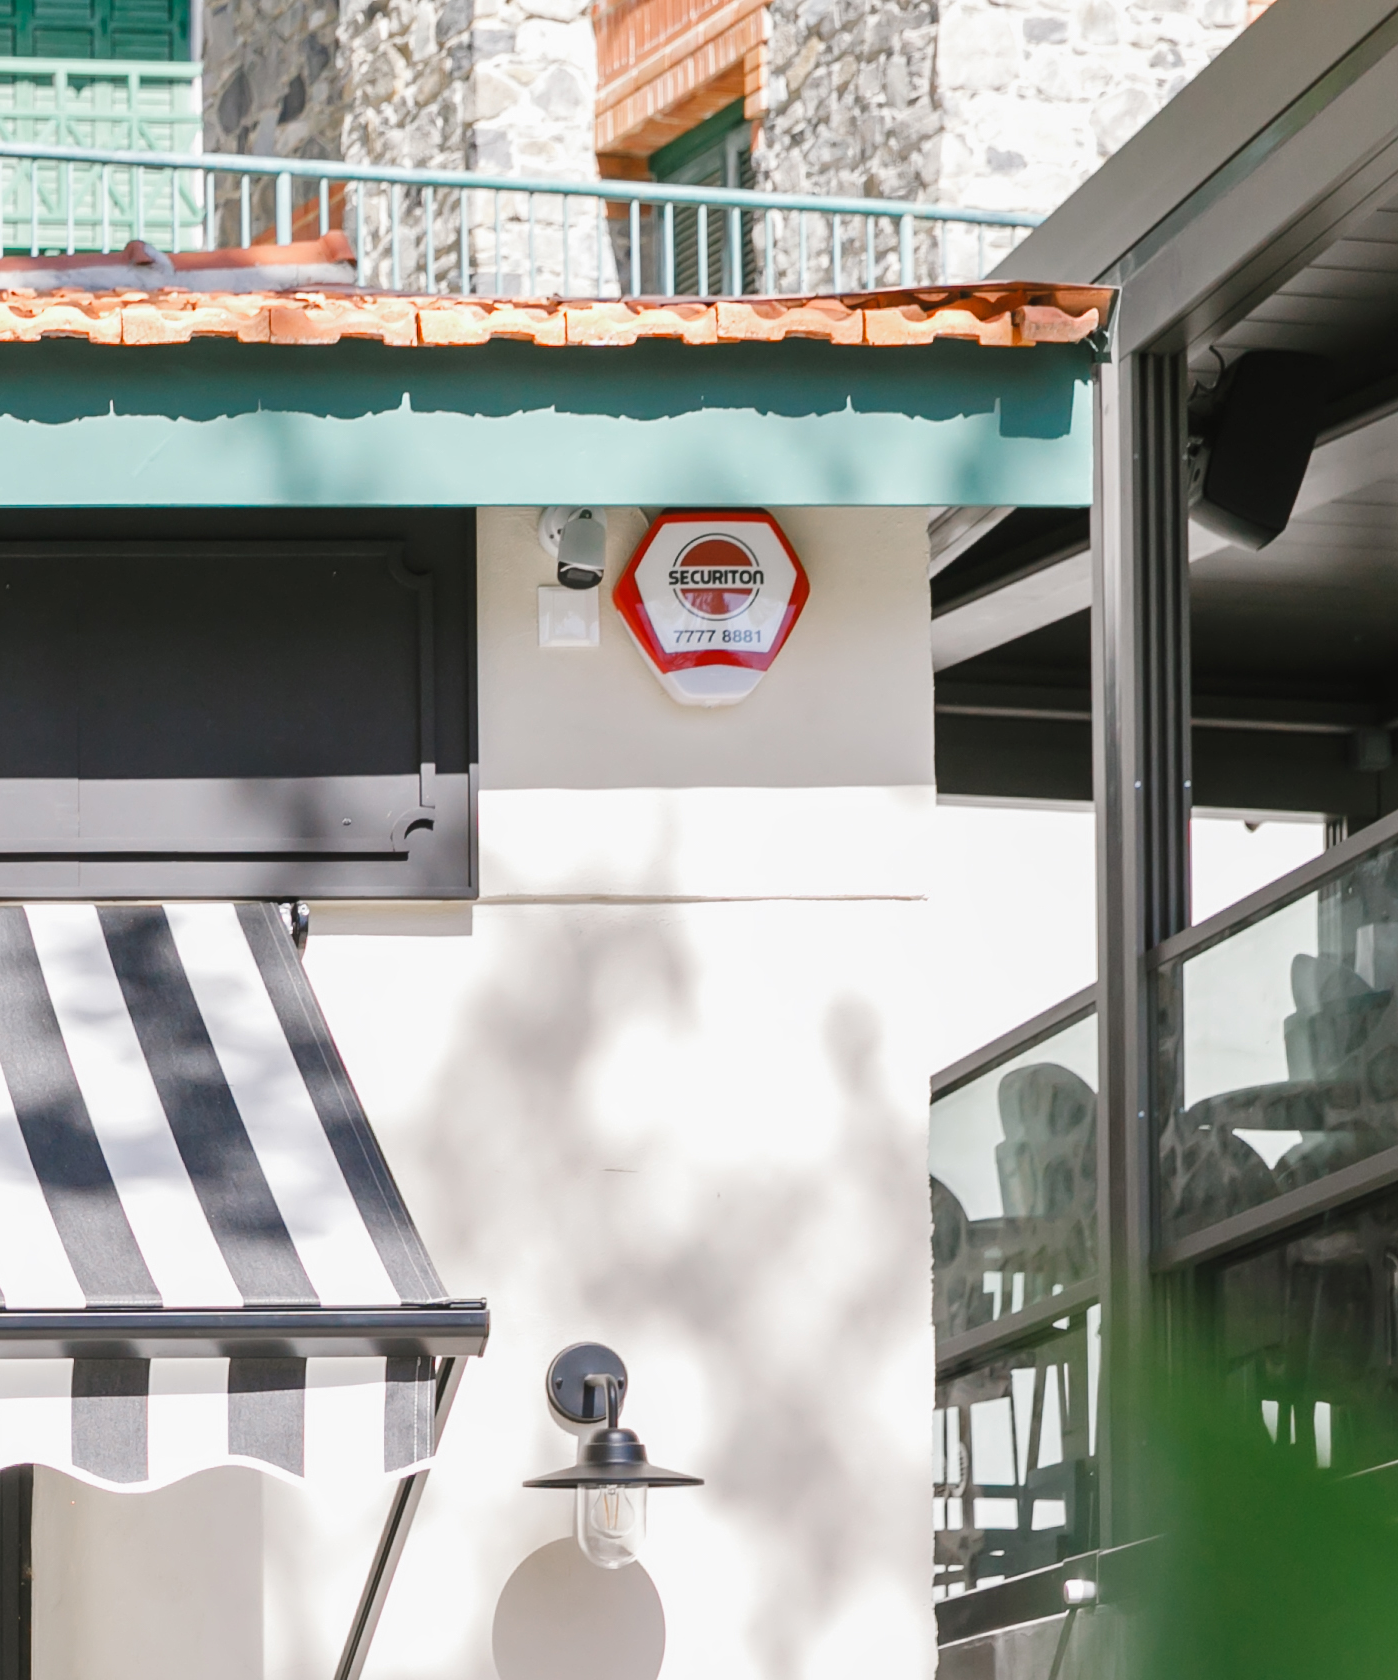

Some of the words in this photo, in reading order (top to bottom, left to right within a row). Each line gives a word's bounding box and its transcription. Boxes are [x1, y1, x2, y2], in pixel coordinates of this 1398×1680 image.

[668, 569, 764, 585] SECURITON
[673, 630, 716, 643] 7777
[722, 630, 762, 643] 8881
